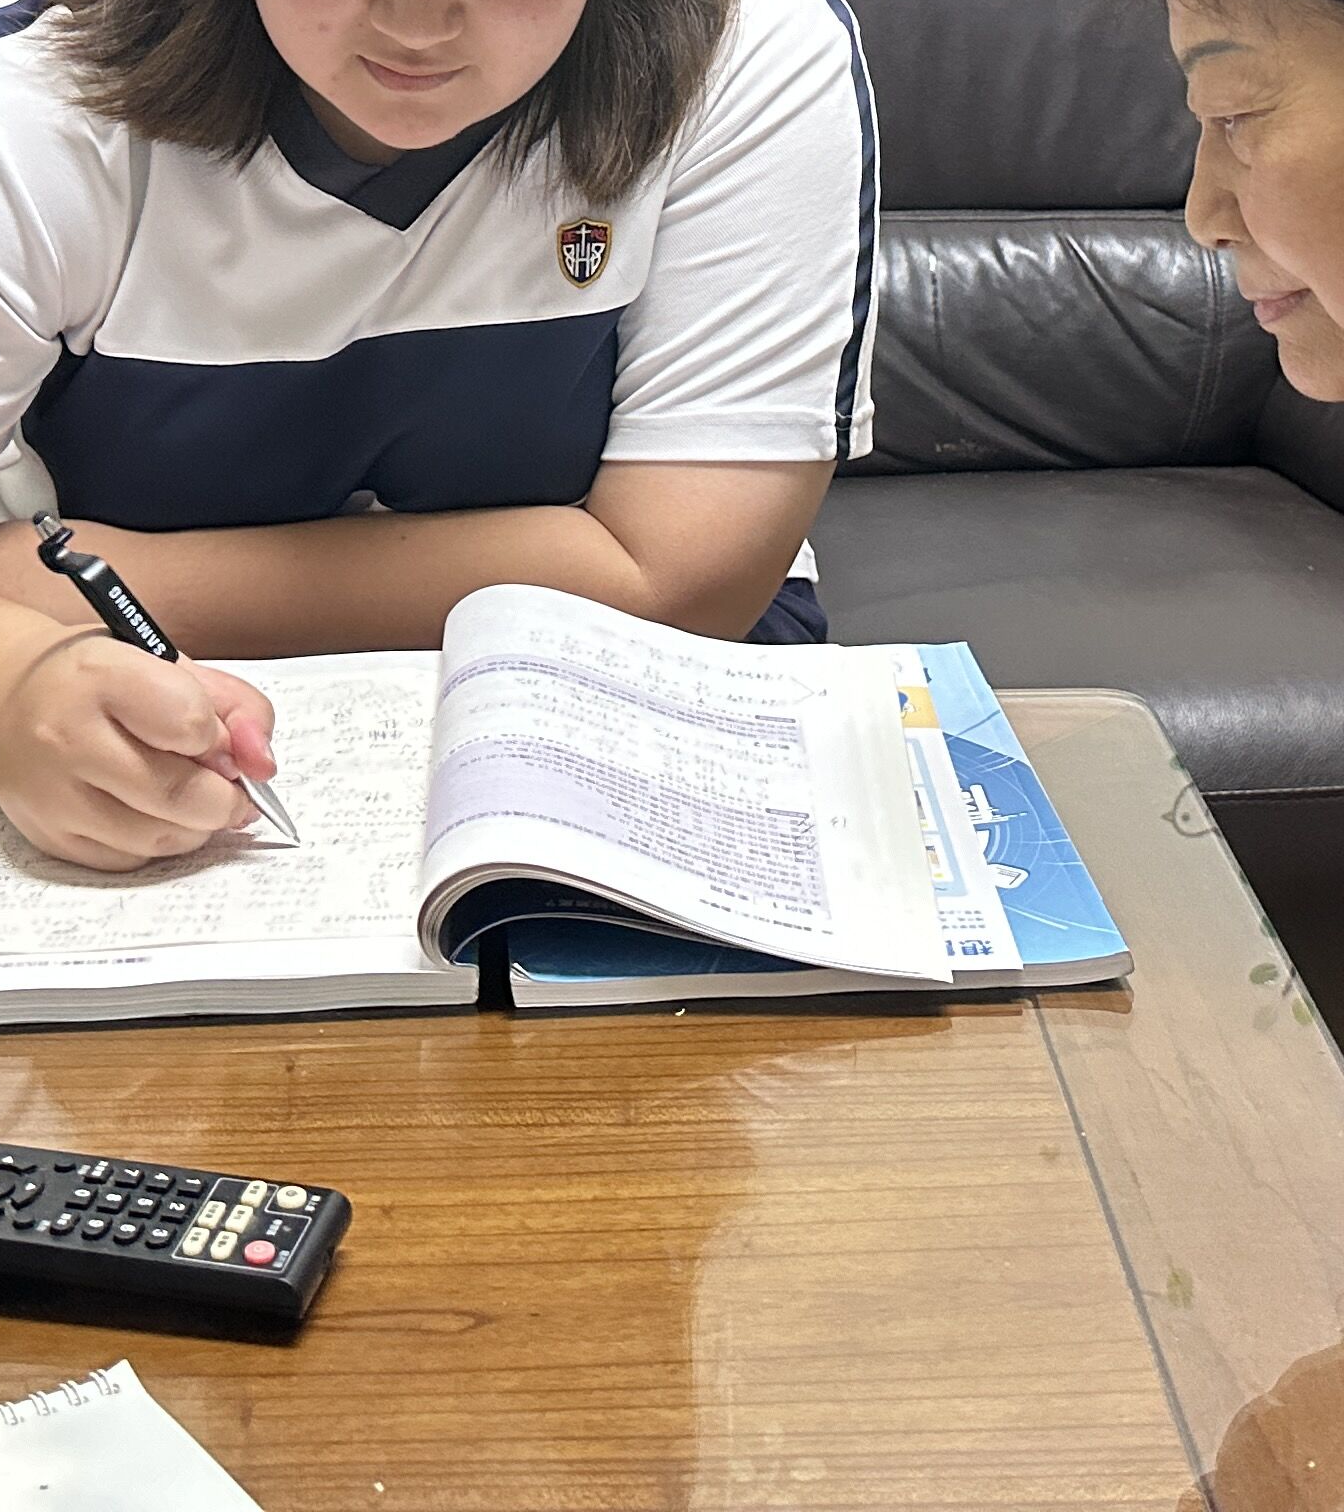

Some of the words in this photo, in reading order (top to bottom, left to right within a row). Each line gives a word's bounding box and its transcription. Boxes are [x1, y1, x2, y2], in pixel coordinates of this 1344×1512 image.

[108, 585, 167, 657] SAMSUNG
[124, 1168, 140, 1177] 7
[169, 1203, 185, 1211] 2
